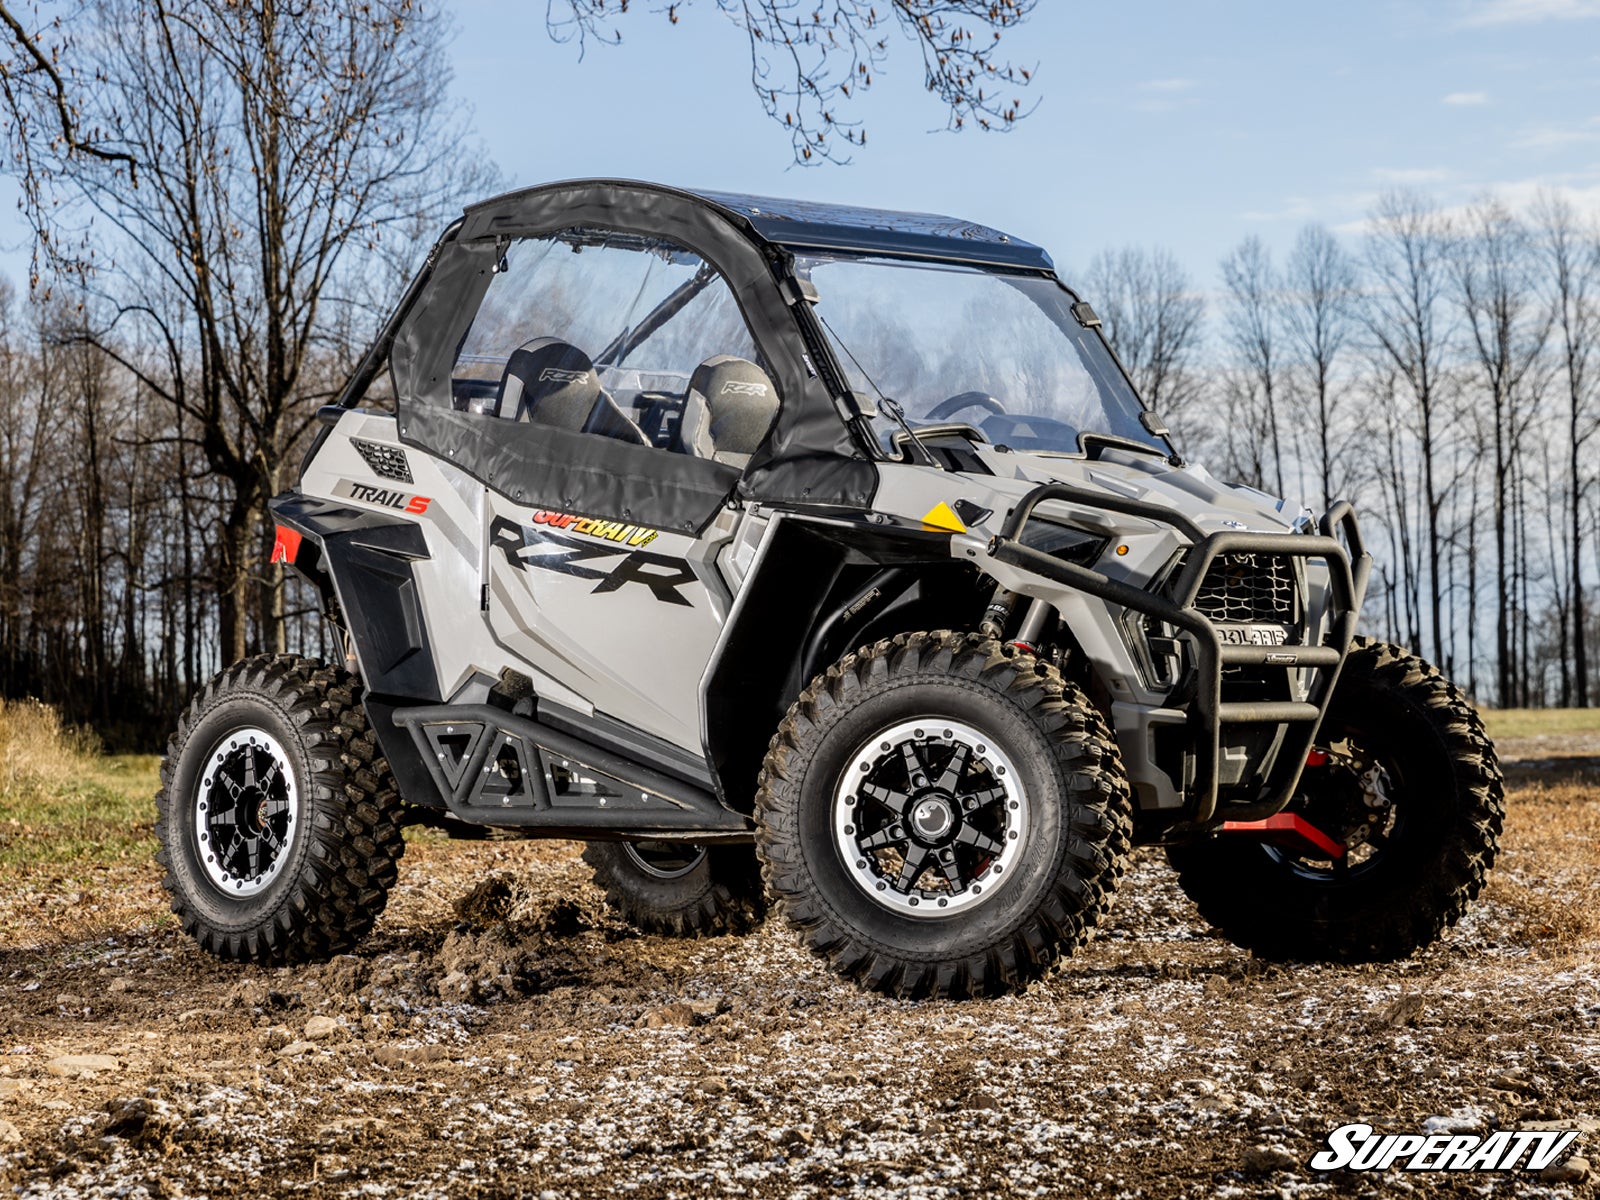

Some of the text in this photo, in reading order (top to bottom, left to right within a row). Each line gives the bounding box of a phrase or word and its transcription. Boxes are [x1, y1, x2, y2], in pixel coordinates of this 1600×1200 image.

[538, 367, 589, 385] RZR
[721, 380, 768, 397] RZR
[350, 483, 432, 515] TRAIL S
[490, 514, 700, 608] RZR
